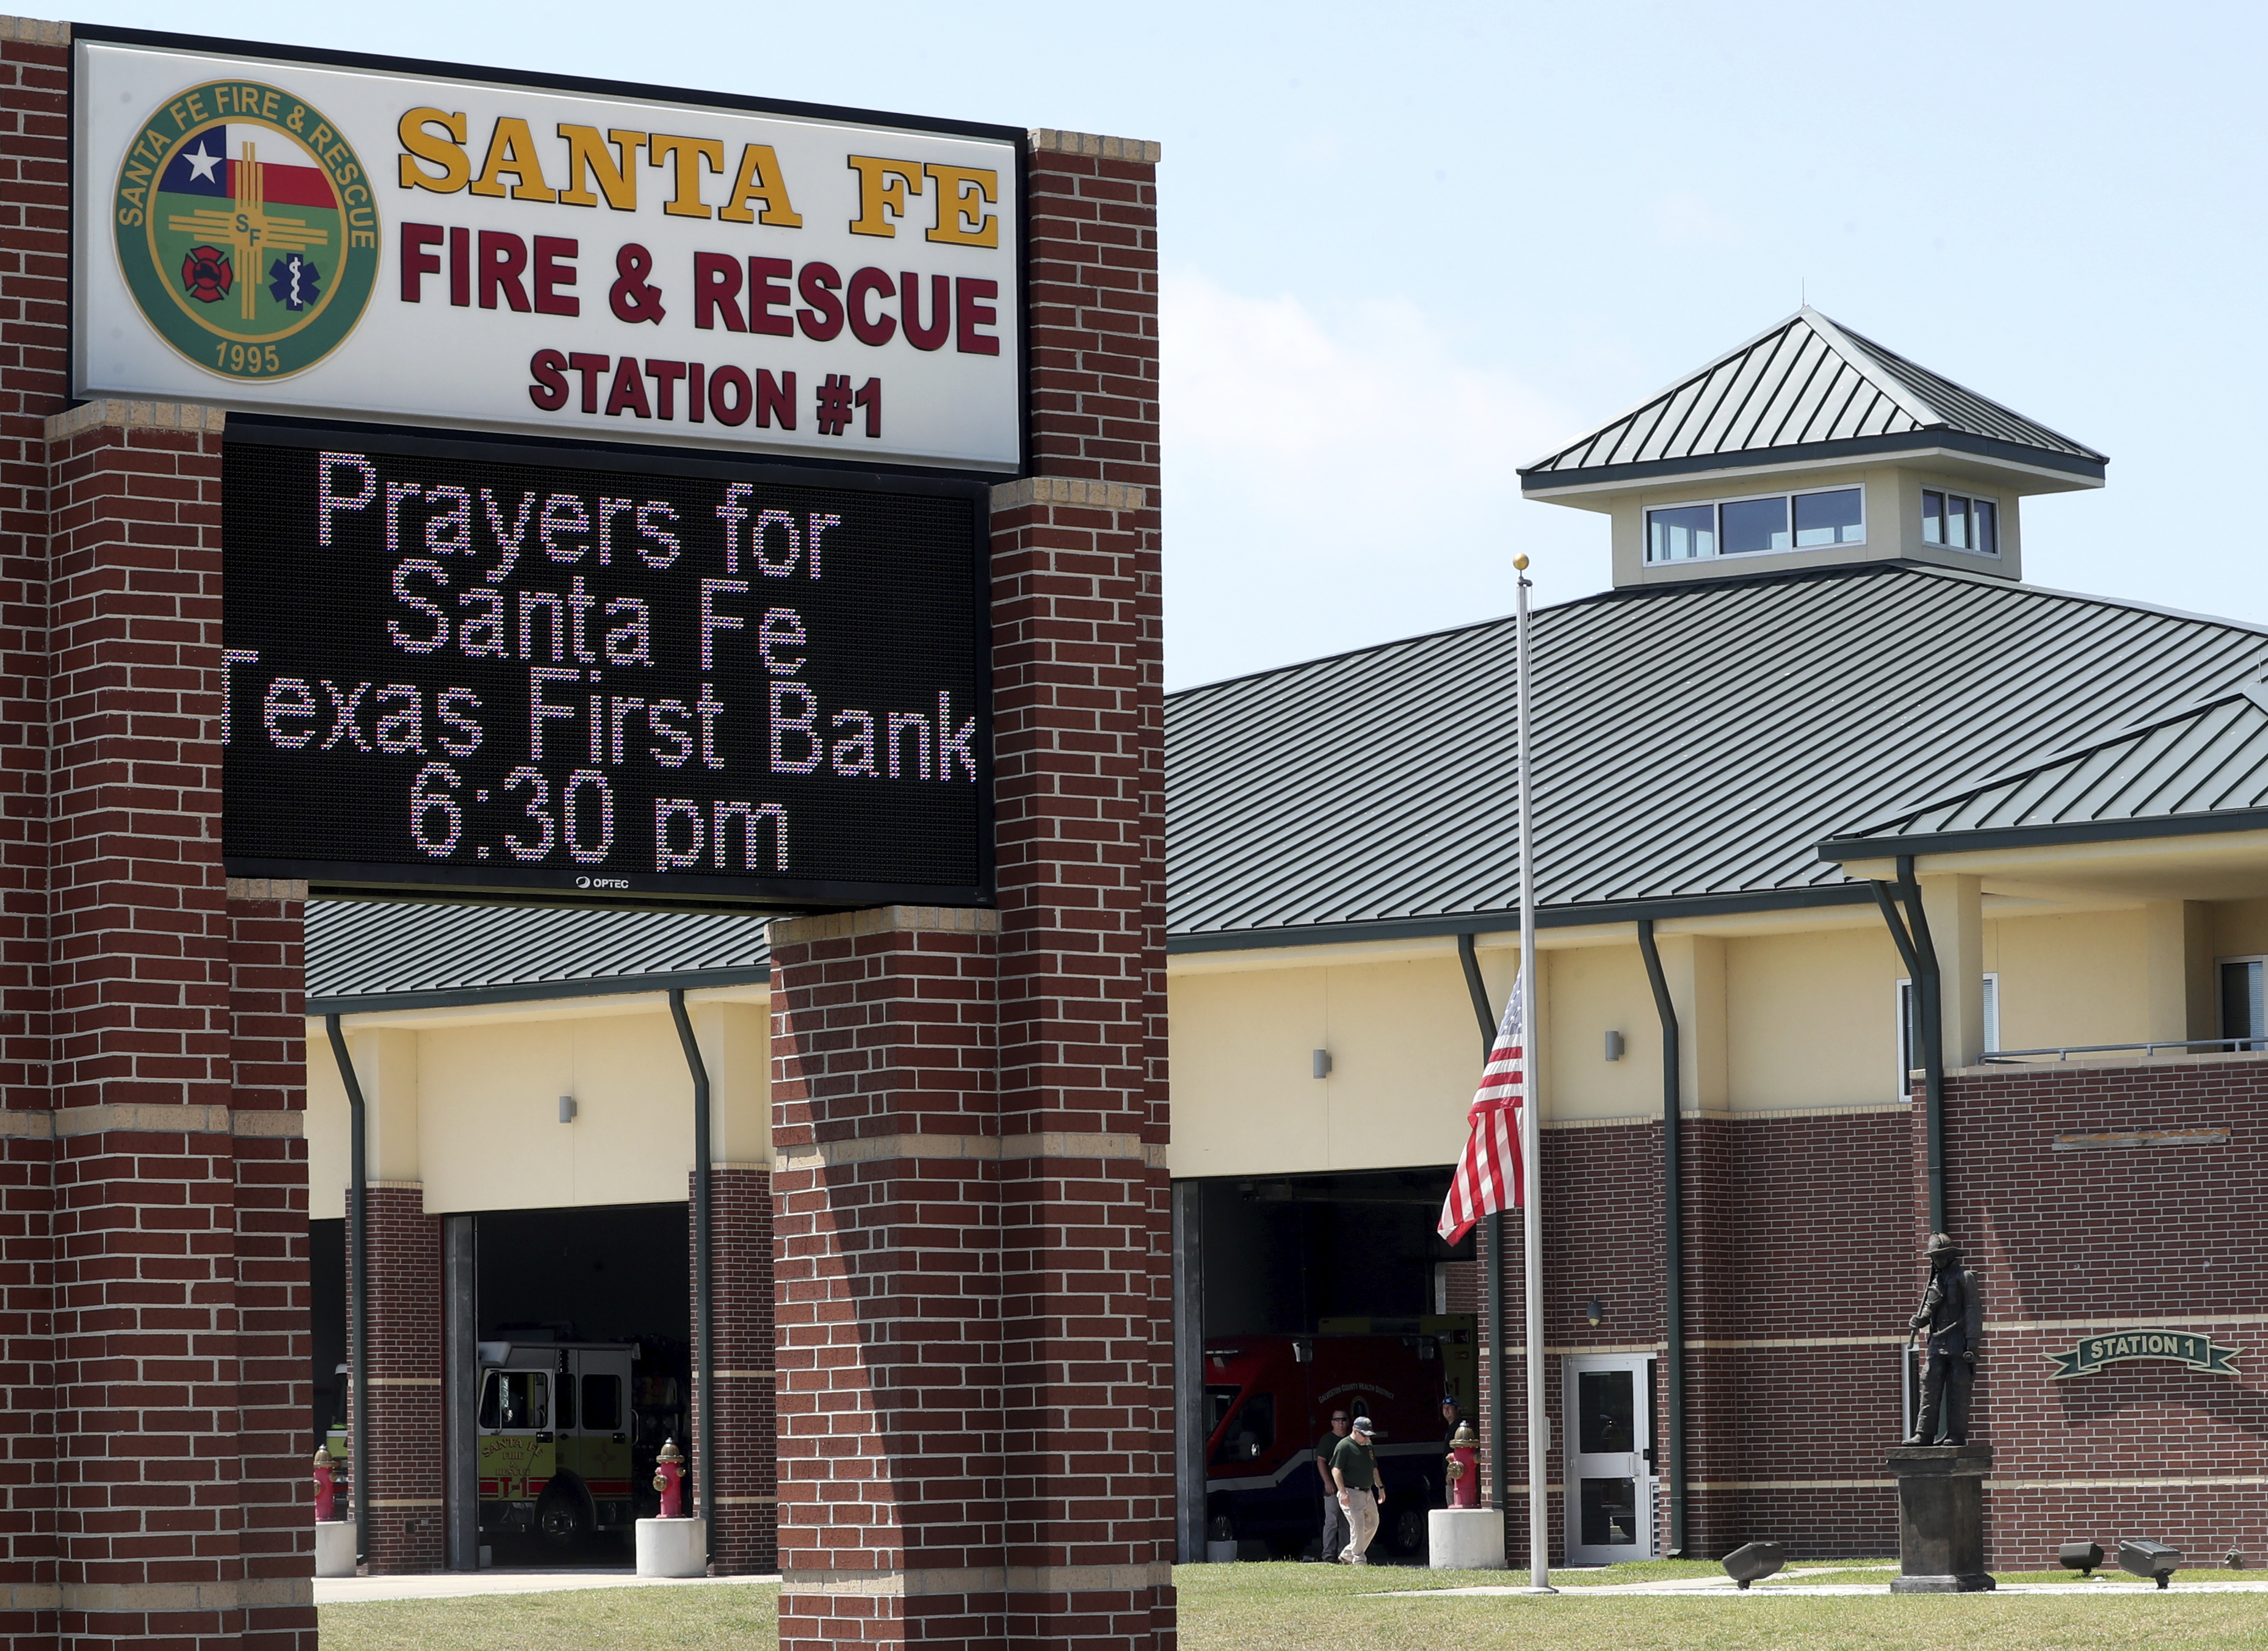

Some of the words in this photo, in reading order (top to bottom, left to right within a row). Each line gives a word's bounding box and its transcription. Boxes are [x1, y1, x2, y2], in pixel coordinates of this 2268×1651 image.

[118, 128, 172, 227] SANTA
[169, 93, 209, 131] FE
[214, 86, 281, 120] FIRE
[286, 105, 305, 133] &
[307, 124, 375, 248] RESCUE
[397, 106, 803, 228] SANTA
[848, 154, 999, 248] FE
[400, 222, 580, 317] FIRE
[609, 243, 666, 325] &
[693, 250, 1000, 356] RESCUE
[216, 341, 280, 374] 1995
[529, 349, 797, 431] STATION
[816, 374, 882, 438] #1
[319, 452, 679, 582] Prayers
[716, 483, 841, 579] for
[387, 558, 654, 666] Santa
[701, 578, 806, 675] Fe
[531, 666, 725, 770] First
[770, 681, 976, 782] Bank
[410, 762, 613, 862] 6:30
[656, 798, 788, 872] pm
[593, 878, 629, 889] OPTEC
[1341, 1383, 1358, 1392] COUNTY
[1358, 1382, 1375, 1392] HEALTH
[2091, 1335, 2178, 1359] STATION
[2185, 1339, 2195, 1357] 1
[482, 1438, 523, 1458] SANTA
[526, 1442, 543, 1458] FE
[501, 1477, 527, 1497] T-1
